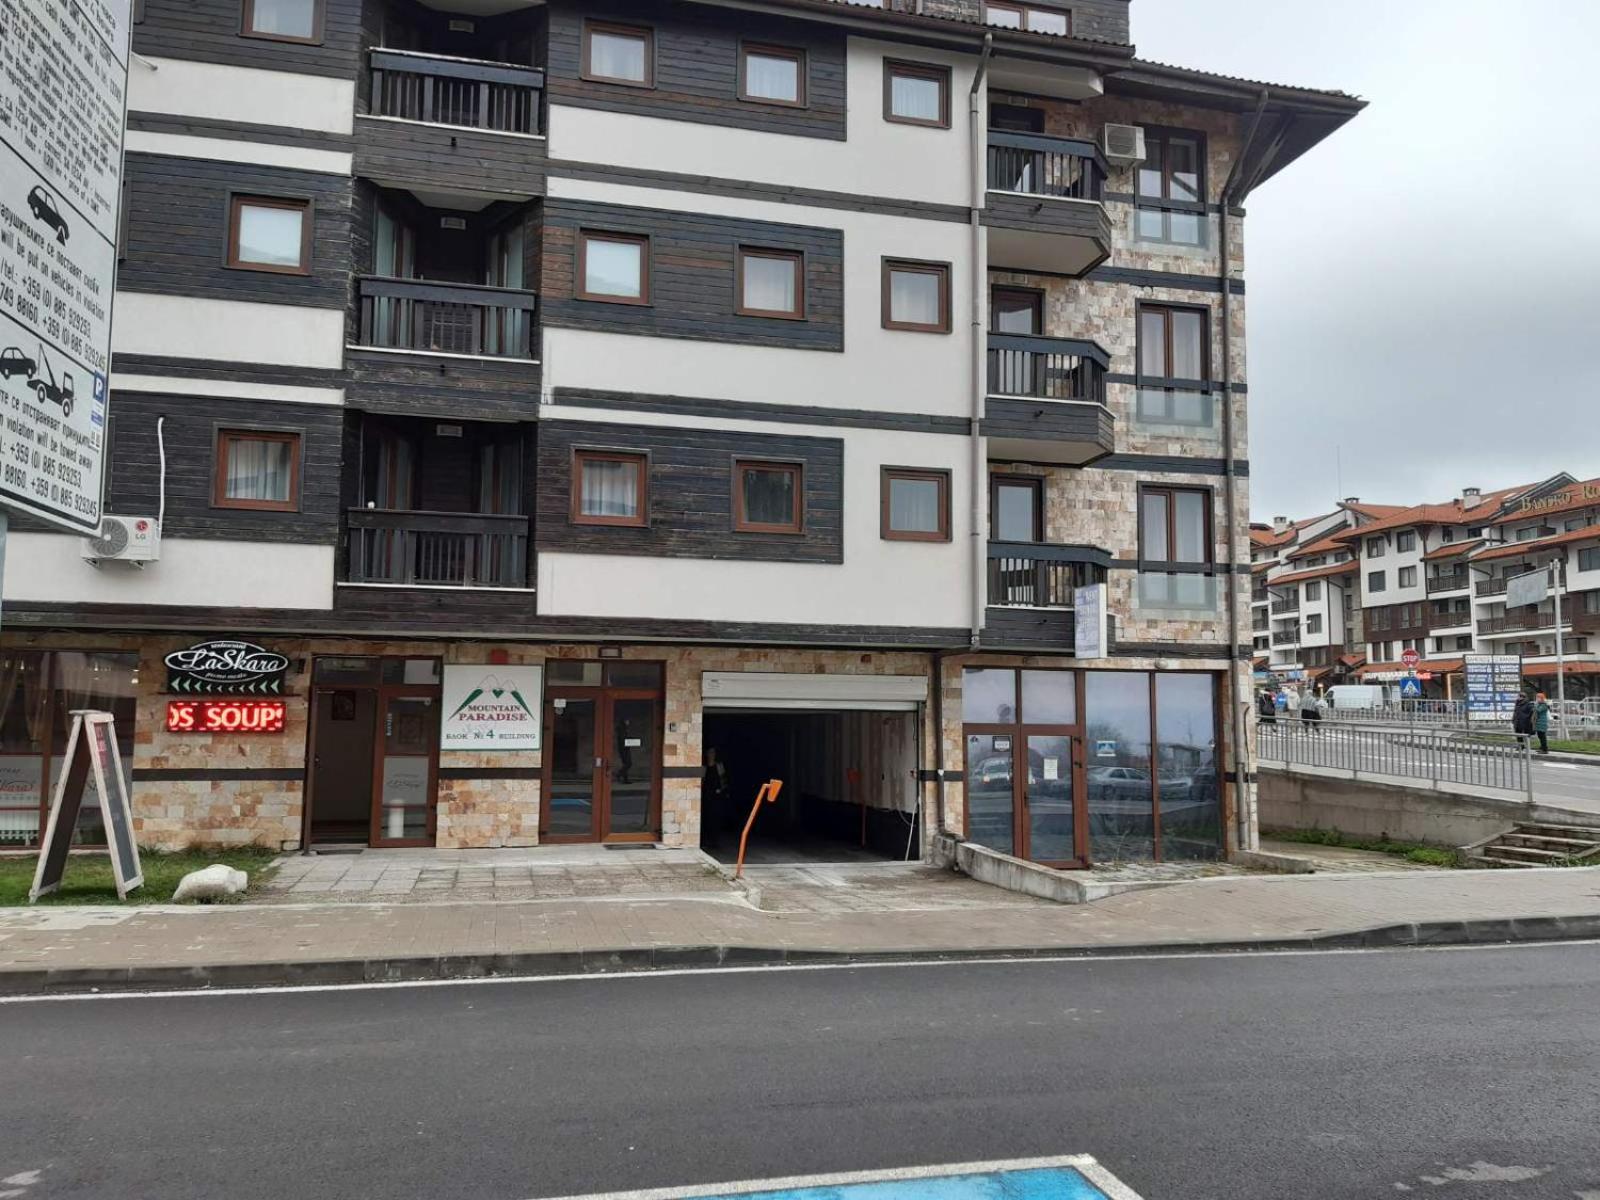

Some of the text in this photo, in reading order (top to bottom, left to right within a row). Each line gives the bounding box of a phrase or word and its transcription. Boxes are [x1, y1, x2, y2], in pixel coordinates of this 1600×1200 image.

[0, 223, 14, 251] will
[16, 236, 24, 259] be
[27, 248, 38, 270] put
[40, 259, 48, 278] on
[50, 268, 74, 298] vehicles
[22, 270, 40, 302] +359
[53, 295, 66, 321] 885
[42, 311, 59, 341] +359
[70, 331, 82, 356] 885
[11, 395, 19, 411] се
[7, 416, 92, 473] violation will be towed away
[10, 438, 28, 465] +359
[42, 454, 55, 477] 885
[30, 473, 48, 498] +359
[60, 486, 72, 508] 885
[74, 492, 96, 518] 929245
[178, 648, 280, 670] LaSkara
[486, 729, 494, 739] 4
